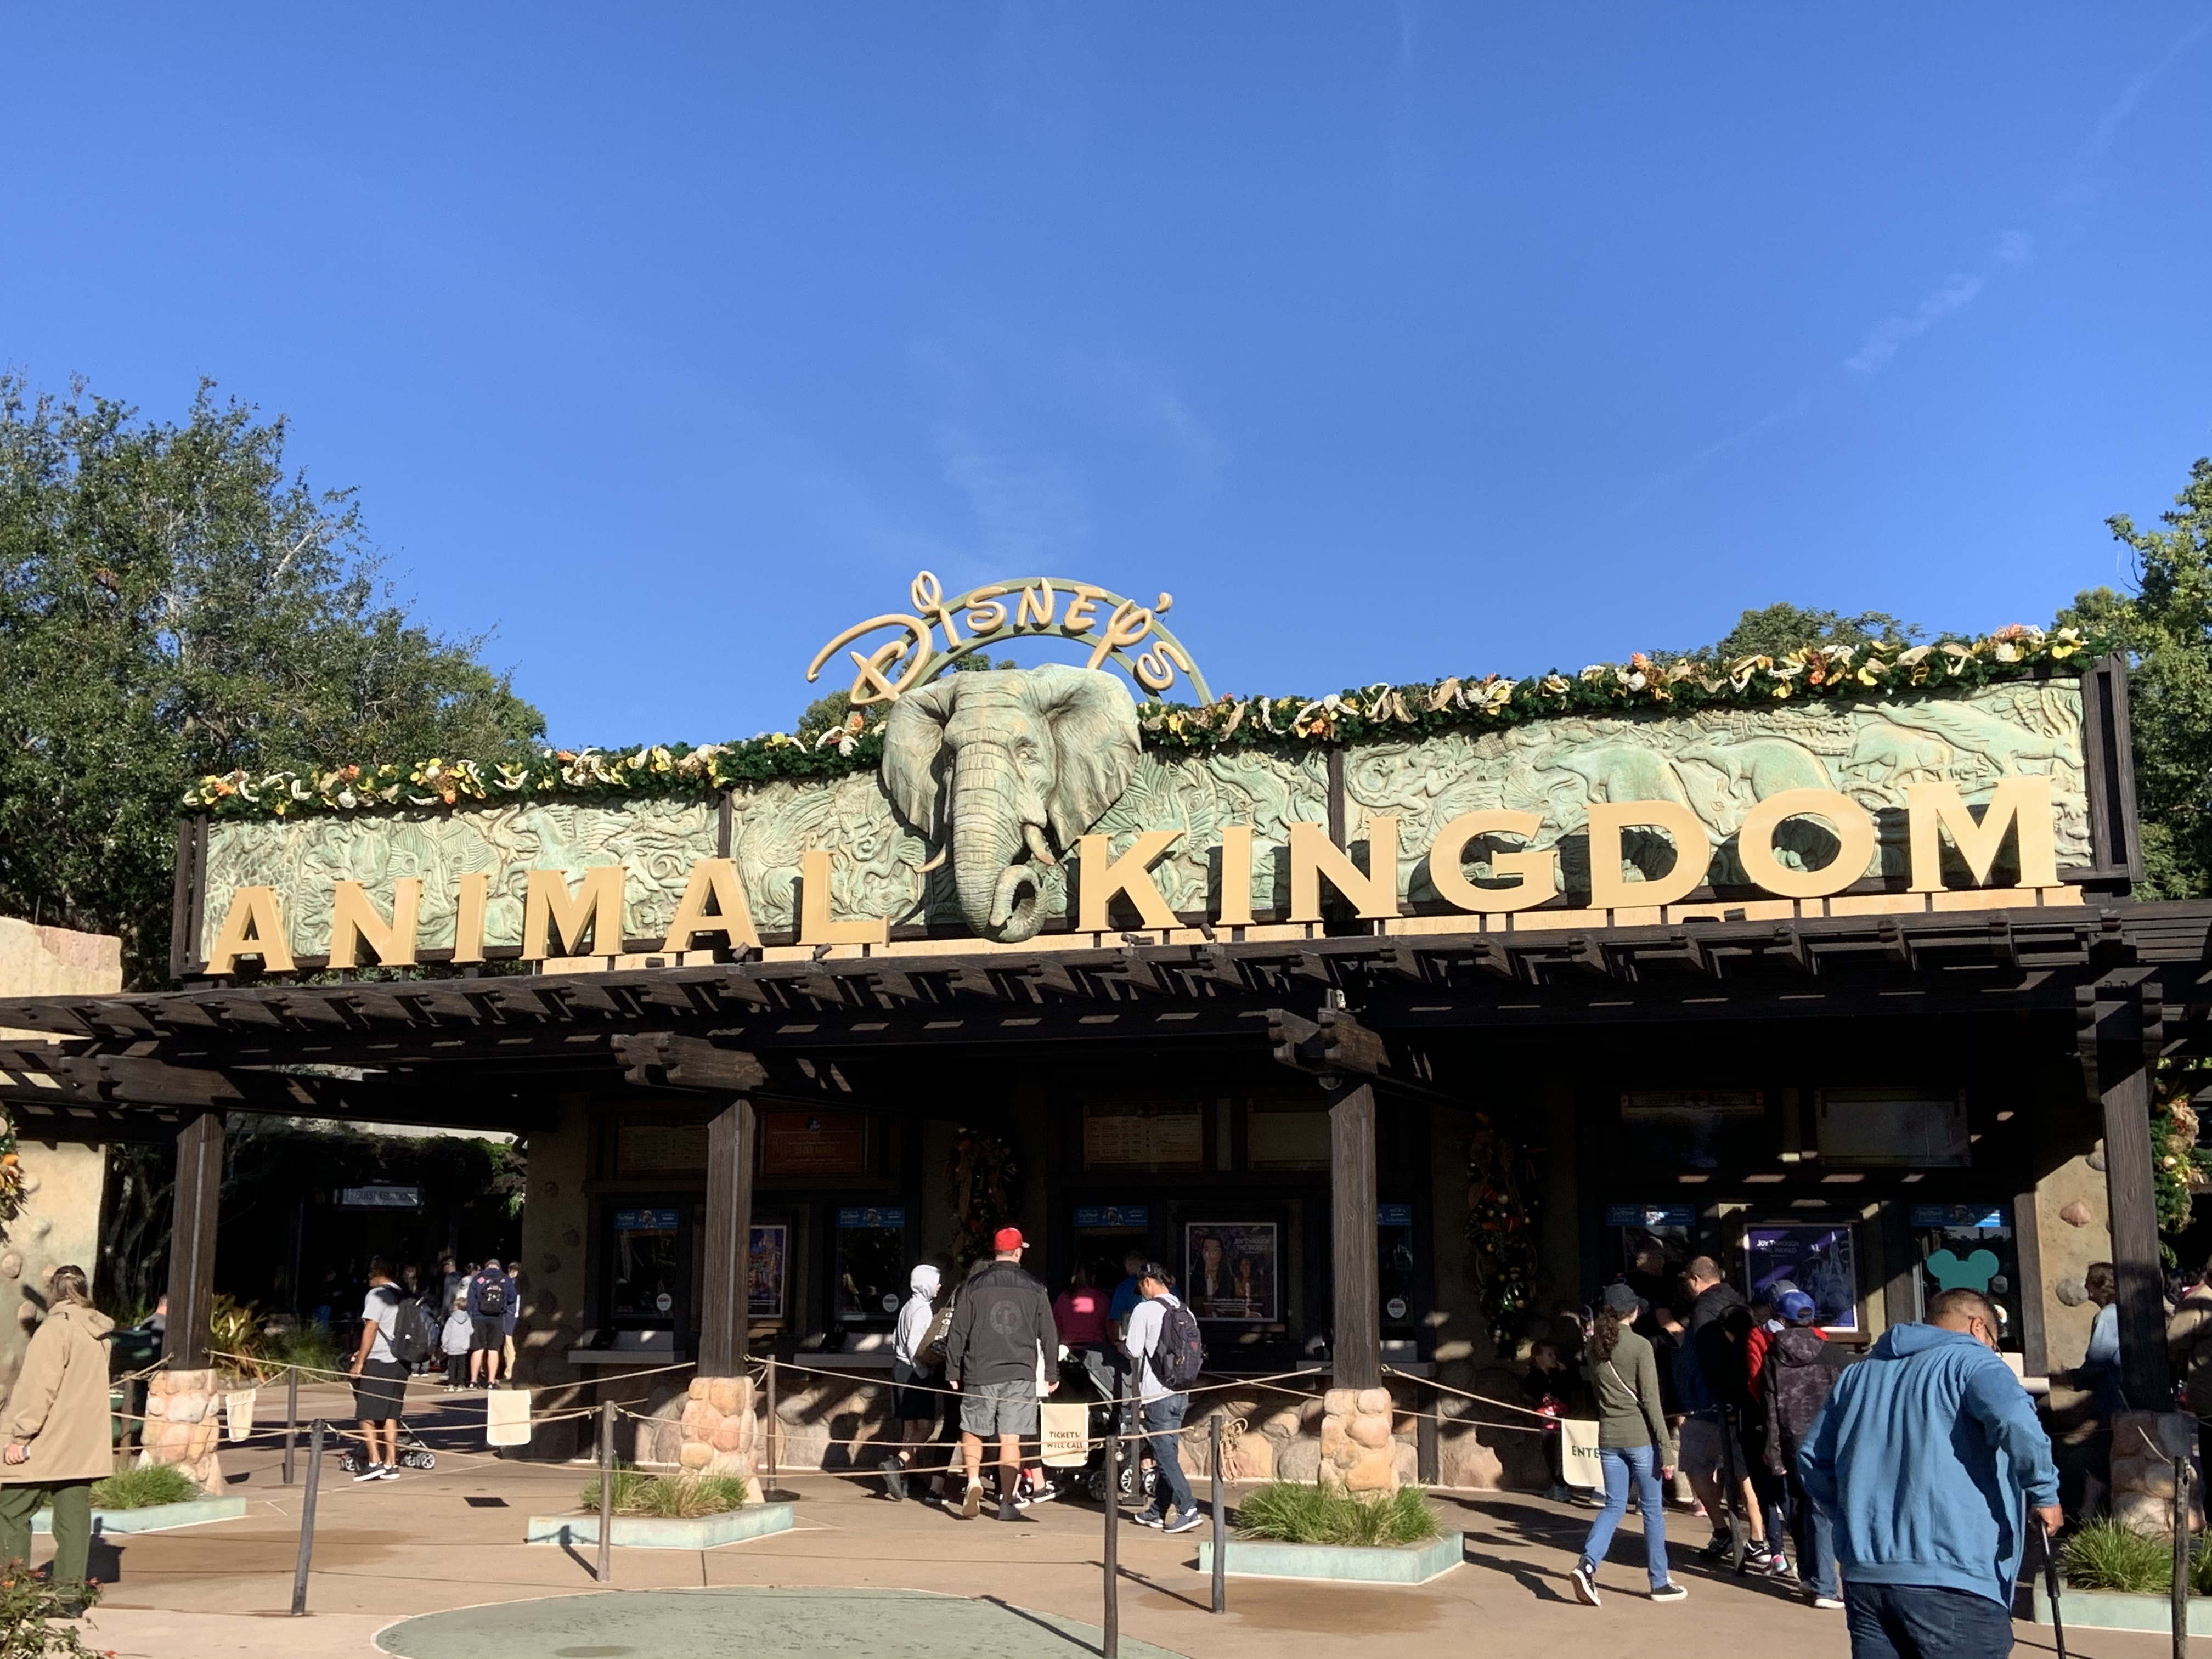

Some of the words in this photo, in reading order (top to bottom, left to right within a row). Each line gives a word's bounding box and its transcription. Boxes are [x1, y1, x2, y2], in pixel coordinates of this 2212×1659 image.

[204, 850, 890, 974] ANIMAL
[1076, 775, 2064, 932] KINGDOM
[1757, 1239, 1769, 1247] JOY
[1572, 1446, 1600, 1458] ENTE
